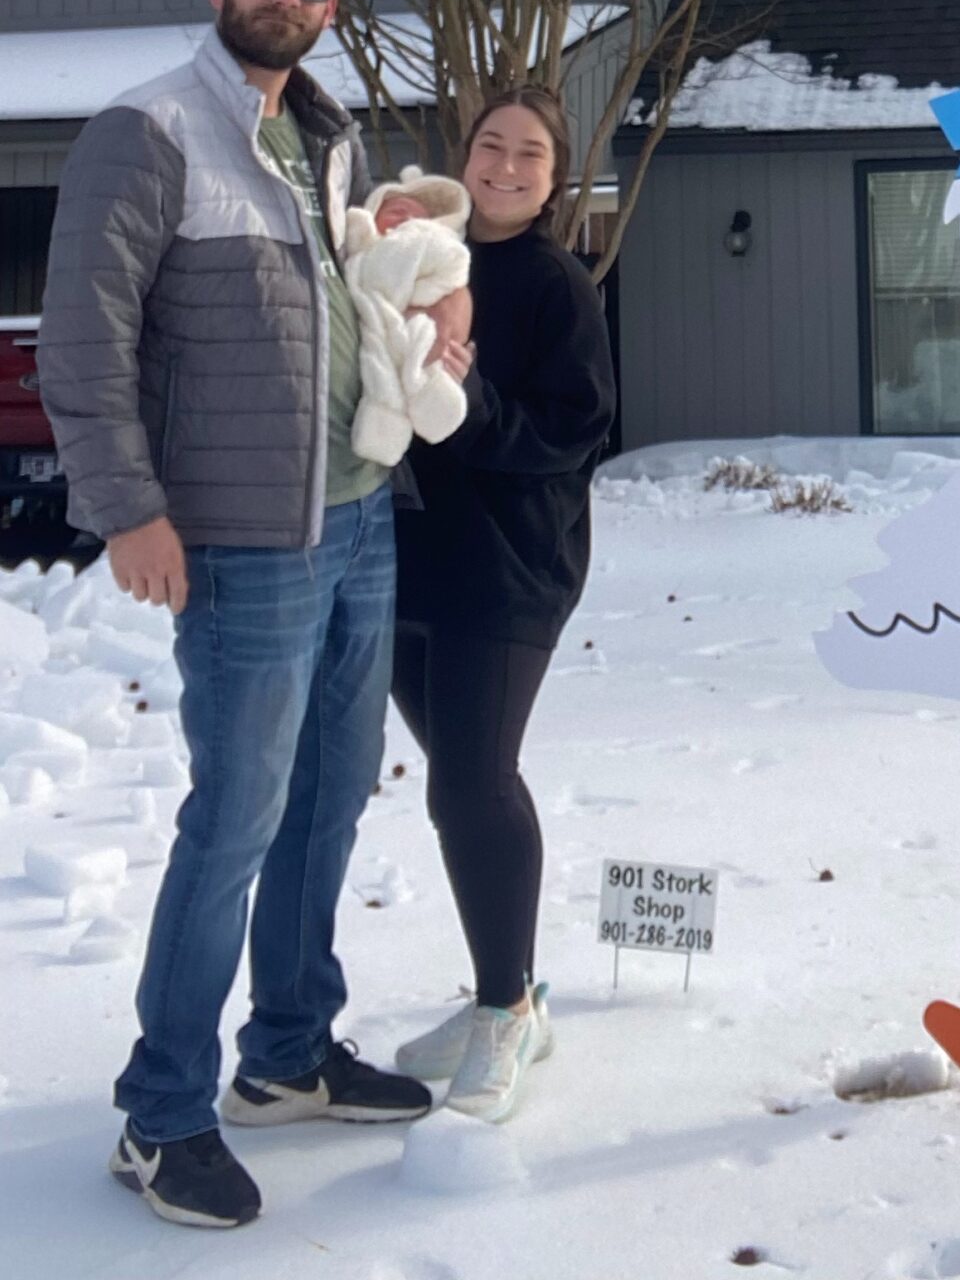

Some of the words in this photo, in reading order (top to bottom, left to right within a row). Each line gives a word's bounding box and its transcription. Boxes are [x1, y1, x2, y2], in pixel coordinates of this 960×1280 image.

[609, 865, 644, 889] 901
[652, 869, 713, 896] Stork
[632, 895, 685, 924] Shop
[600, 920, 713, 950] 901-286-2019
